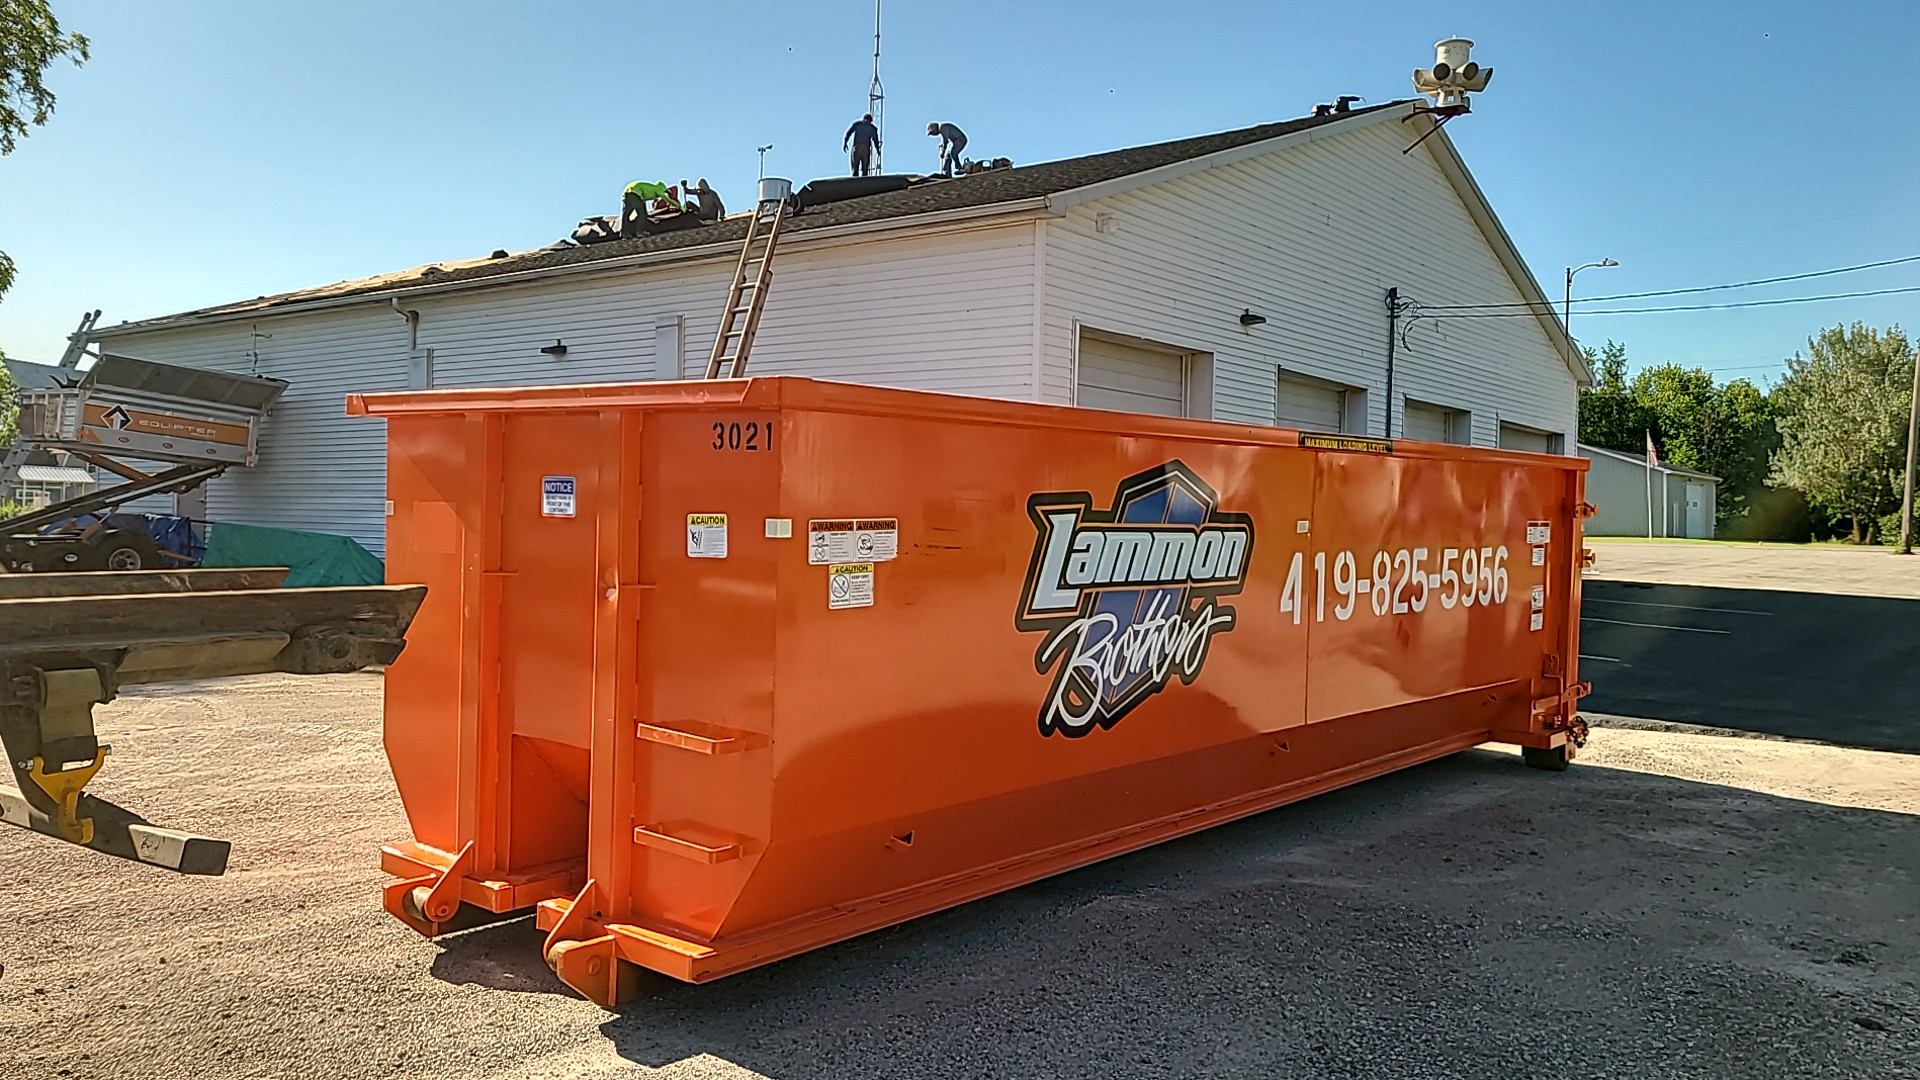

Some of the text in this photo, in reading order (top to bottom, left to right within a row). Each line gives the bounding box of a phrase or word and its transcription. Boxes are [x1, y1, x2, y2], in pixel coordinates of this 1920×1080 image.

[138, 419, 217, 436] EQUIPTER
[712, 422, 772, 451] 3021
[1304, 437, 1387, 453] MAXIMUM LOADING LEVEL
[545, 482, 572, 492] NOTICE
[695, 516, 725, 525] CAUTION
[817, 522, 852, 531] WARNING
[862, 521, 895, 530] WARNING
[839, 564, 869, 573] CAUTION
[1031, 513, 1247, 610] Lammon
[1280, 545, 1508, 625] 419-825-5956
[1042, 589, 1232, 726] Brothers
